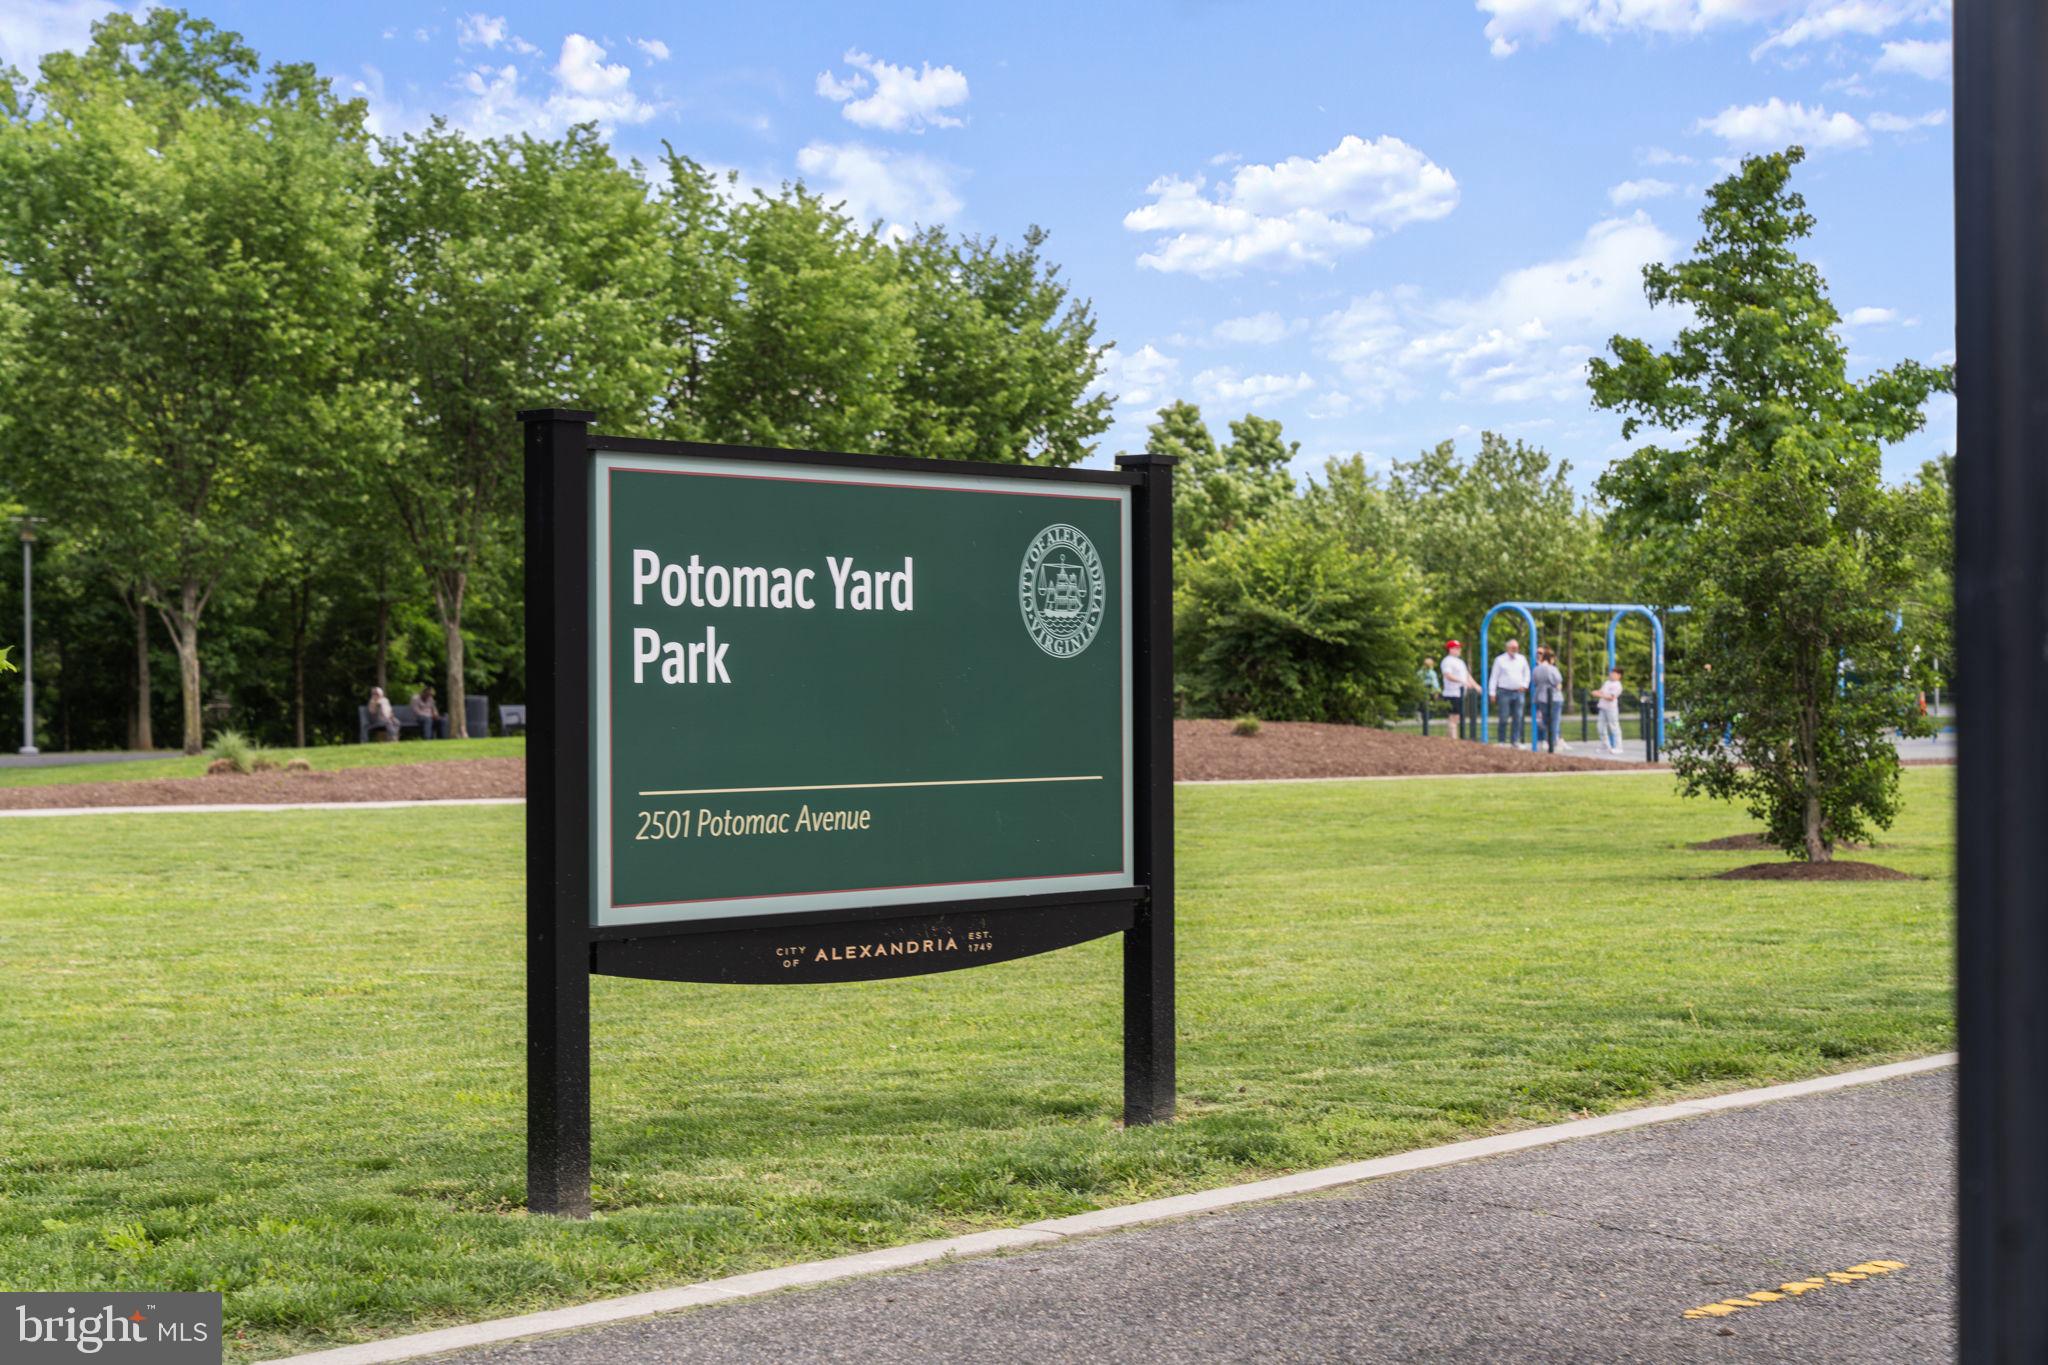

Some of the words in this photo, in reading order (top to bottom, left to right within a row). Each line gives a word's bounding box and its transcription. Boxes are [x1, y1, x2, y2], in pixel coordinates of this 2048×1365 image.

[632, 549, 816, 610] Potomac
[826, 556, 914, 611] Yard
[1022, 560, 1035, 612] CITY
[1030, 537, 1047, 562] OF
[1045, 528, 1102, 612] ALEXANDRIA
[1032, 619, 1097, 654] VIRGINIA
[632, 626, 732, 684] Park
[635, 810, 691, 840] 2501
[697, 808, 790, 837] Potomac
[795, 804, 871, 832] Avenue
[815, 937, 958, 962] ALEXANDRIA
[968, 931, 993, 940] EST.
[968, 942, 993, 952] 1749
[776, 946, 806, 956] CITY
[783, 959, 800, 968] OF
